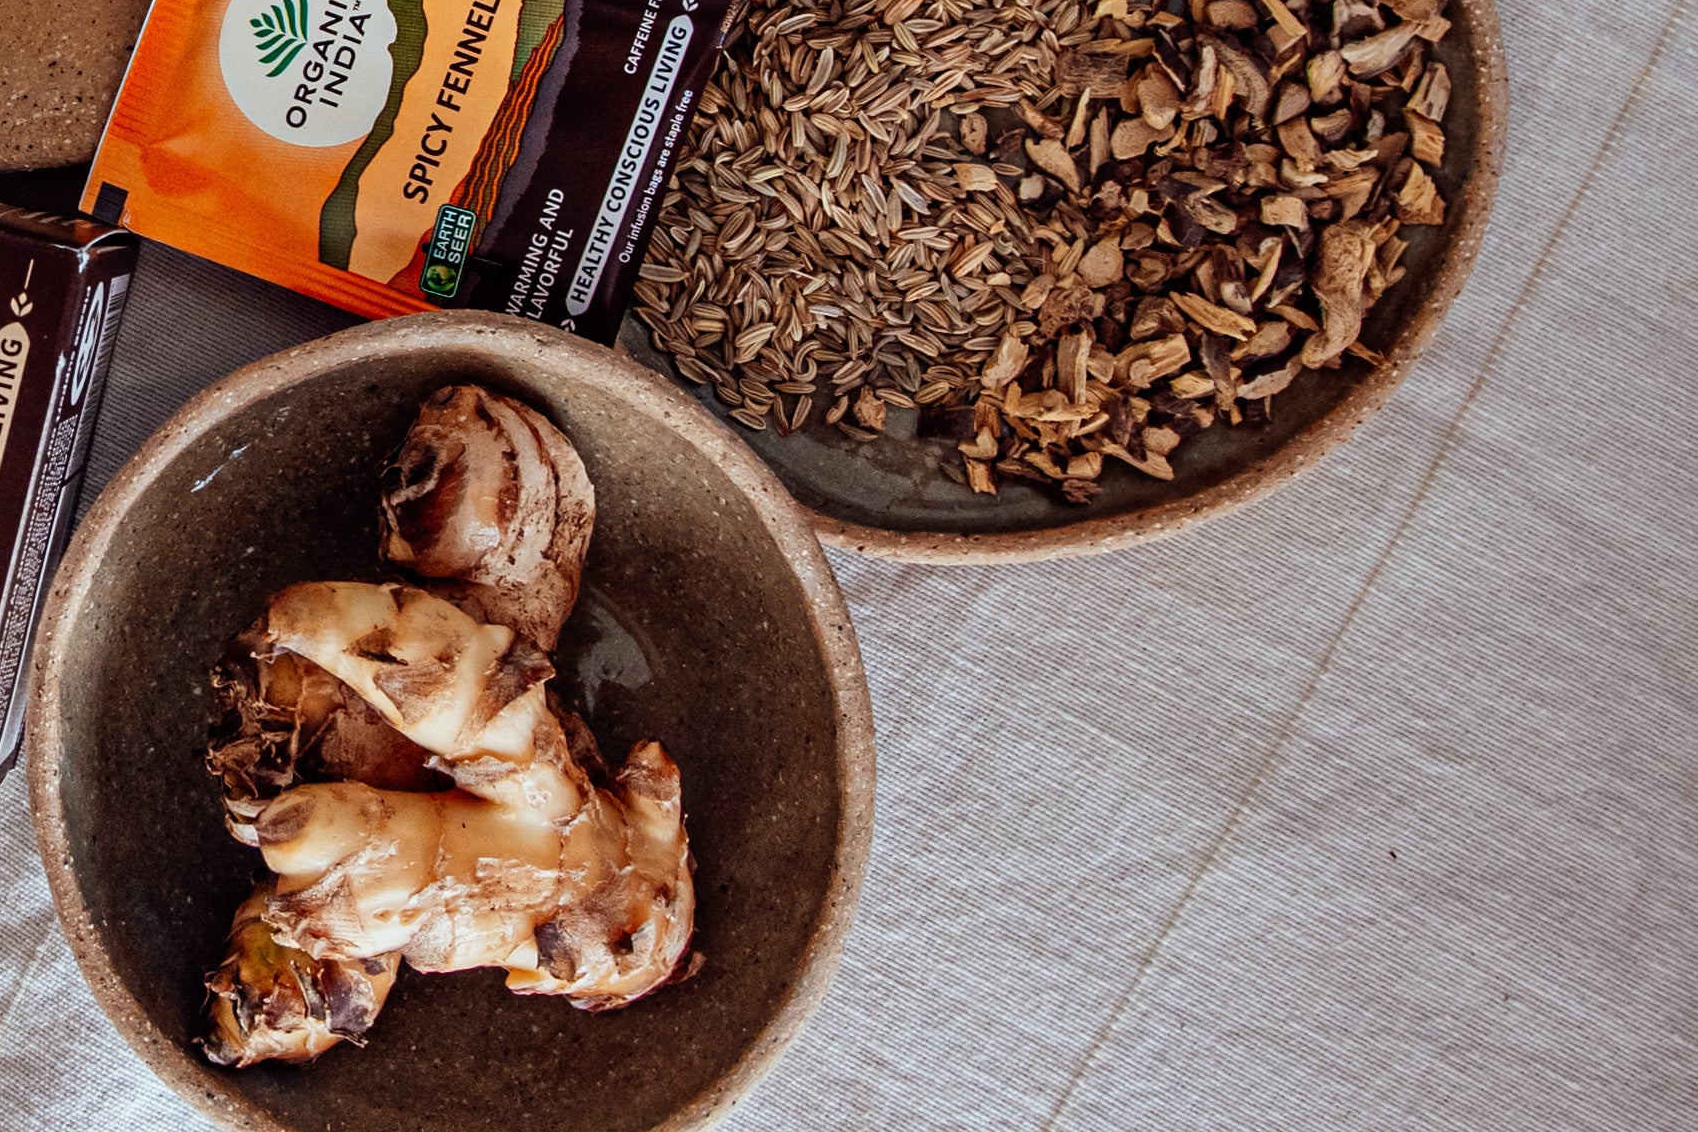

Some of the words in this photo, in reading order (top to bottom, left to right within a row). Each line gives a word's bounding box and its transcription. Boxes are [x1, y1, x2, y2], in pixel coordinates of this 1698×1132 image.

[624, 8, 657, 75] CAFFEINE
[403, 112, 453, 205] SPICY
[570, 216, 615, 304] HEALTHY
[606, 97, 660, 213] CONSCIOUS
[650, 25, 688, 94] LIVING
[619, 241, 635, 264] Our
[630, 197, 652, 241] infusion
[644, 169, 663, 195] bags
[657, 148, 671, 167] are
[665, 112, 684, 149] staple
[676, 89, 693, 113] free
[432, 209, 457, 260] EARTH
[447, 214, 473, 264] SEER
[505, 233, 548, 318] WARMING
[539, 188, 565, 231] AND
[525, 229, 574, 320] LAVORFUL
